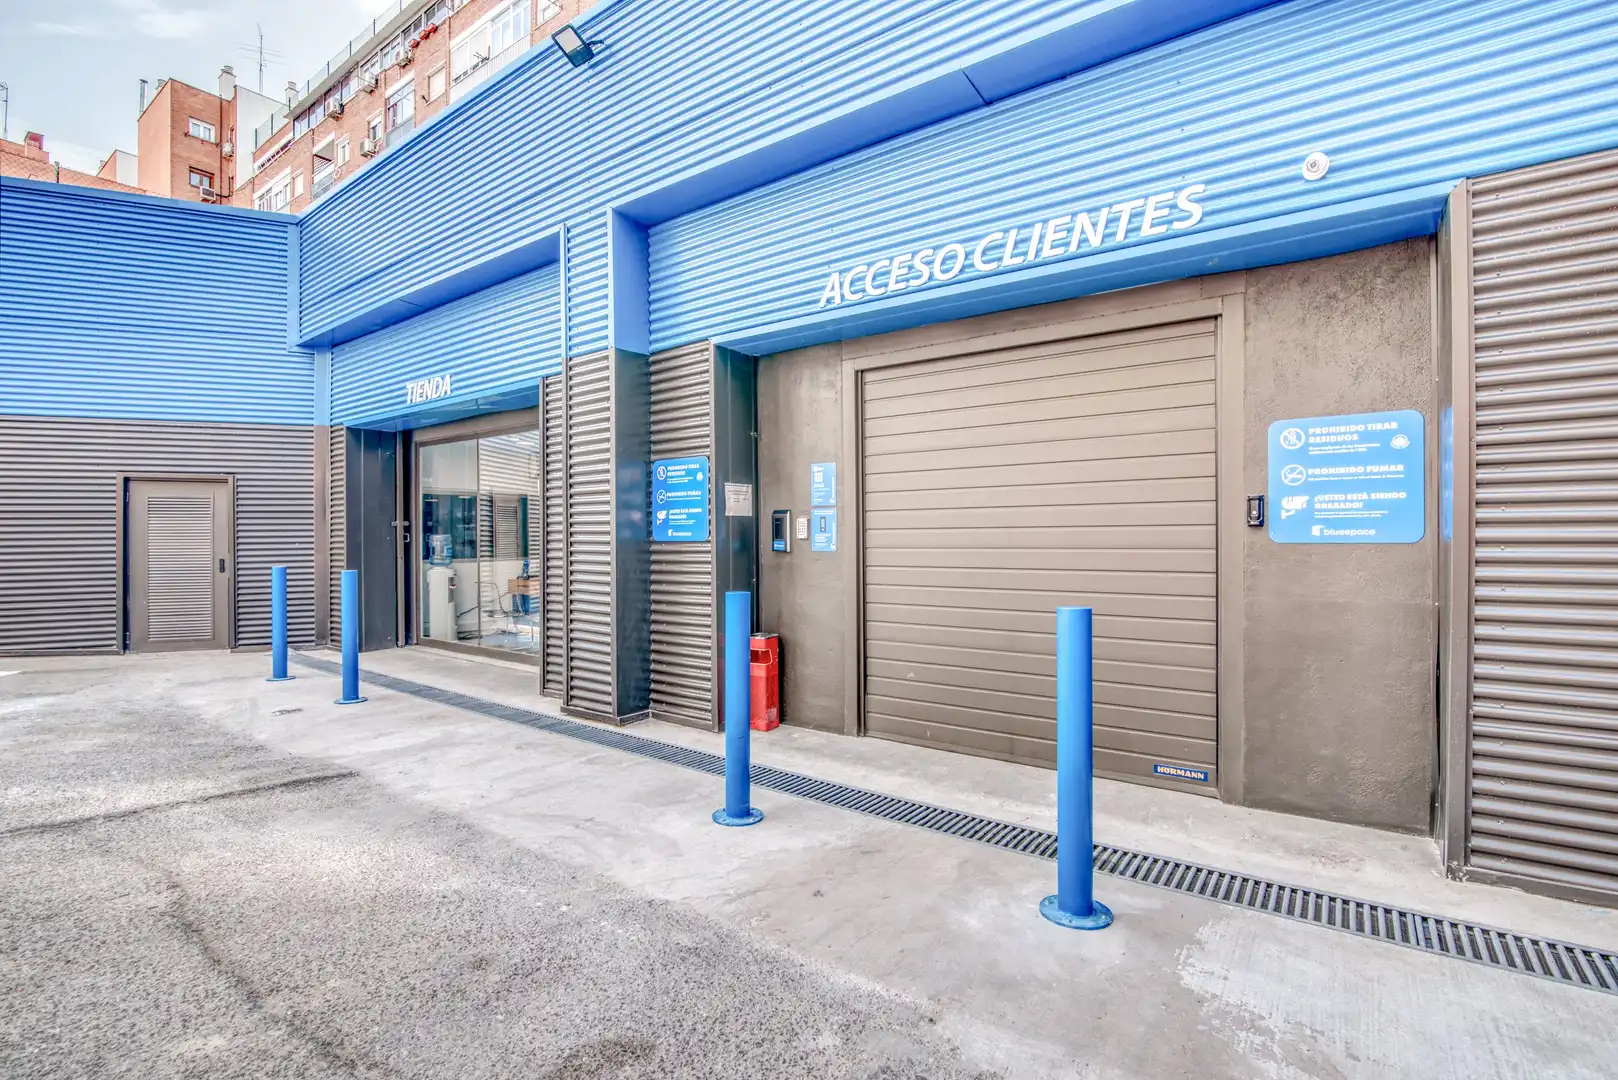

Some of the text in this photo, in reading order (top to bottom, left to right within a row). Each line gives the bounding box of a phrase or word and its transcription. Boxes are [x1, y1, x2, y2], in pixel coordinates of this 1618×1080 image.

[819, 184, 1205, 307] ACCESO CLIENTES
[406, 374, 452, 405] TIENDA
[1308, 421, 1398, 434] PROHIBIDO TIRAR
[1308, 433, 1359, 443] RESIDUOS
[1308, 464, 1405, 475] PROHIBIDO FUMAR
[1370, 491, 1407, 500] SIENDO
[1323, 526, 1376, 537] bluespace
